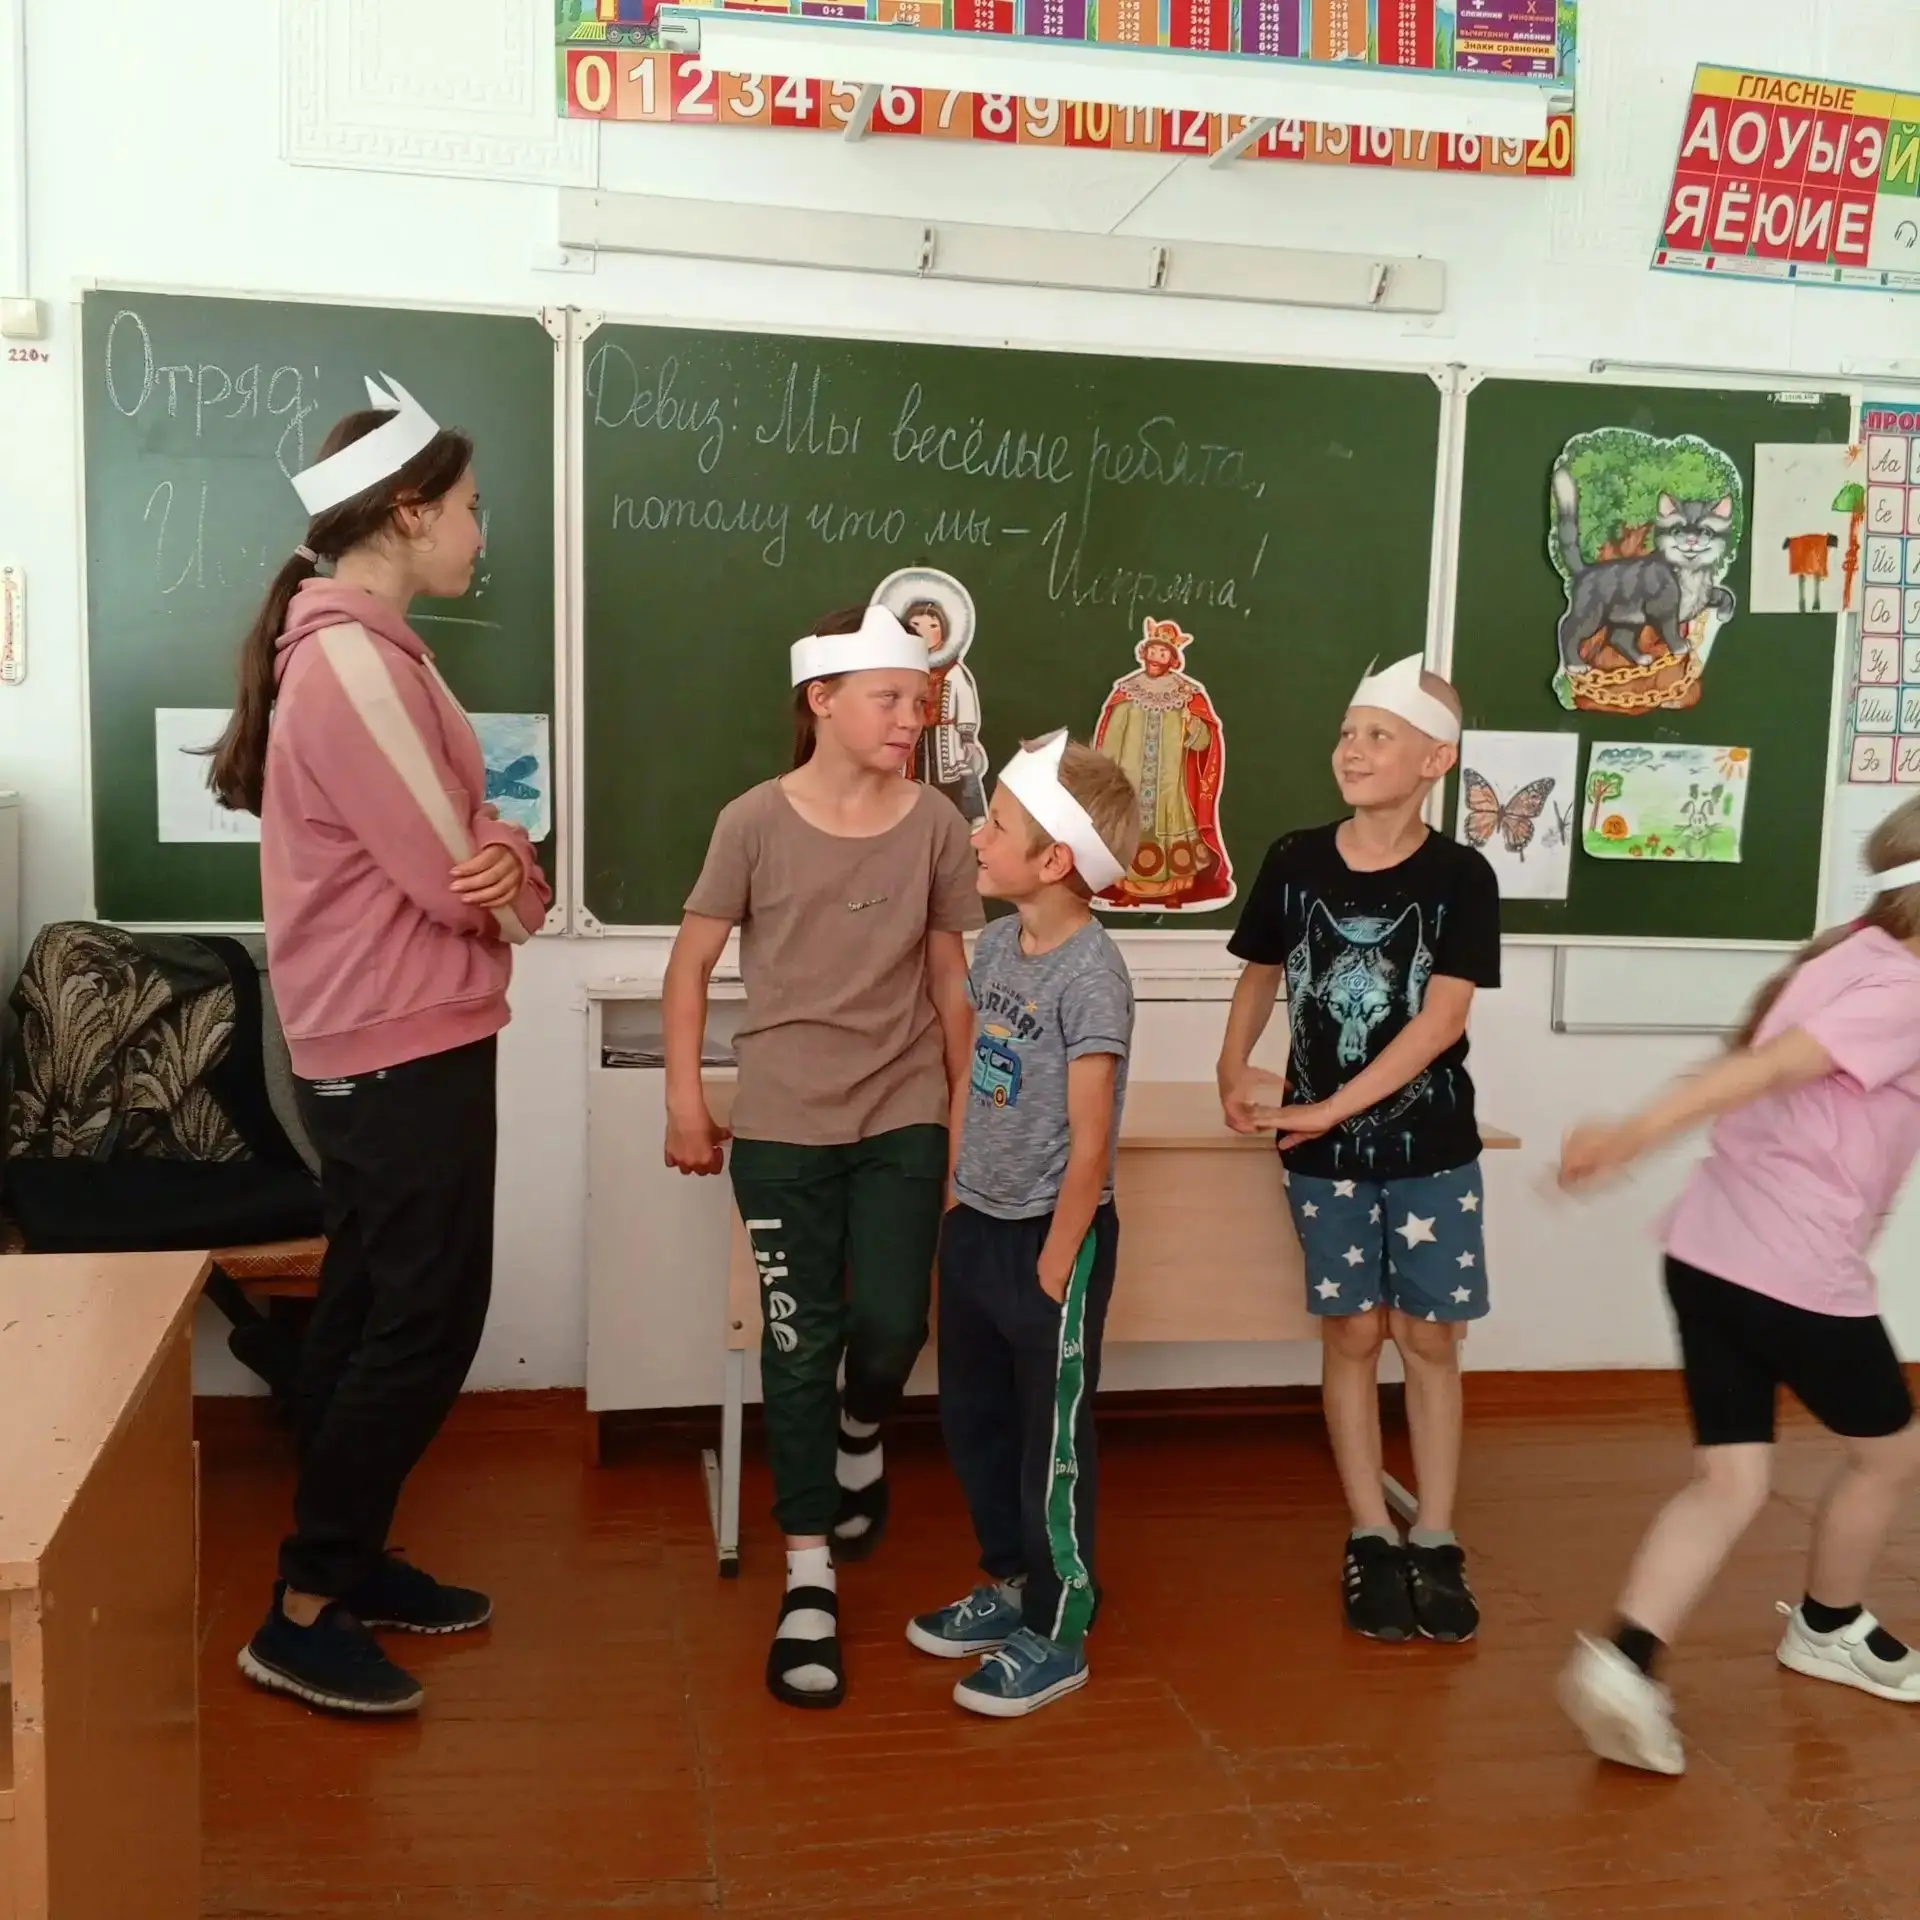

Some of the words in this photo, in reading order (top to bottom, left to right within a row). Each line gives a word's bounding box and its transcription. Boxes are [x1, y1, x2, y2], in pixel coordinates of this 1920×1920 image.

[822, 6, 844, 16] 0+2
[974, 9, 995, 19] 1+3
[1043, 4, 1064, 14] 1+4
[1043, 14, 1064, 25] 2+3
[1190, 15, 1211, 26] 3+4
[1460, 10, 1503, 20] сложение
[974, 19, 995, 30] 2+2
[1043, 25, 1064, 35] 3+2
[1118, 21, 1140, 31] 3+3
[1259, 22, 1280, 32] 4+4
[1190, 25, 1211, 36] 4+3
[1512, 32, 1551, 41] деление
[1463, 41, 1494, 50] Знаки
[1496, 44, 1550, 55] сравнения
[1736, 74, 1857, 111] ГЛАСНЫЕ
[574, 55, 611, 113] 0
[627, 57, 656, 114] 1
[676, 59, 714, 115] 2
[728, 71, 766, 118] 3
[774, 76, 814, 120] 4
[879, 85, 916, 126] 6
[980, 93, 1012, 134] 8
[1066, 101, 1110, 142] 10
[1118, 104, 1154, 145] 11
[1164, 109, 1207, 147] 12
[1527, 119, 1571, 170] 20
[585, 342, 738, 473] Девиз:
[756, 361, 862, 455] Мы
[889, 381, 1074, 484] весёлые
[1872, 448, 1901, 473] Аа
[612, 493, 788, 567] потому
[806, 502, 906, 544] что
[1872, 545, 1896, 574] Йй
[1870, 598, 1892, 625] Оо
[1867, 648, 1889, 681] Уу
